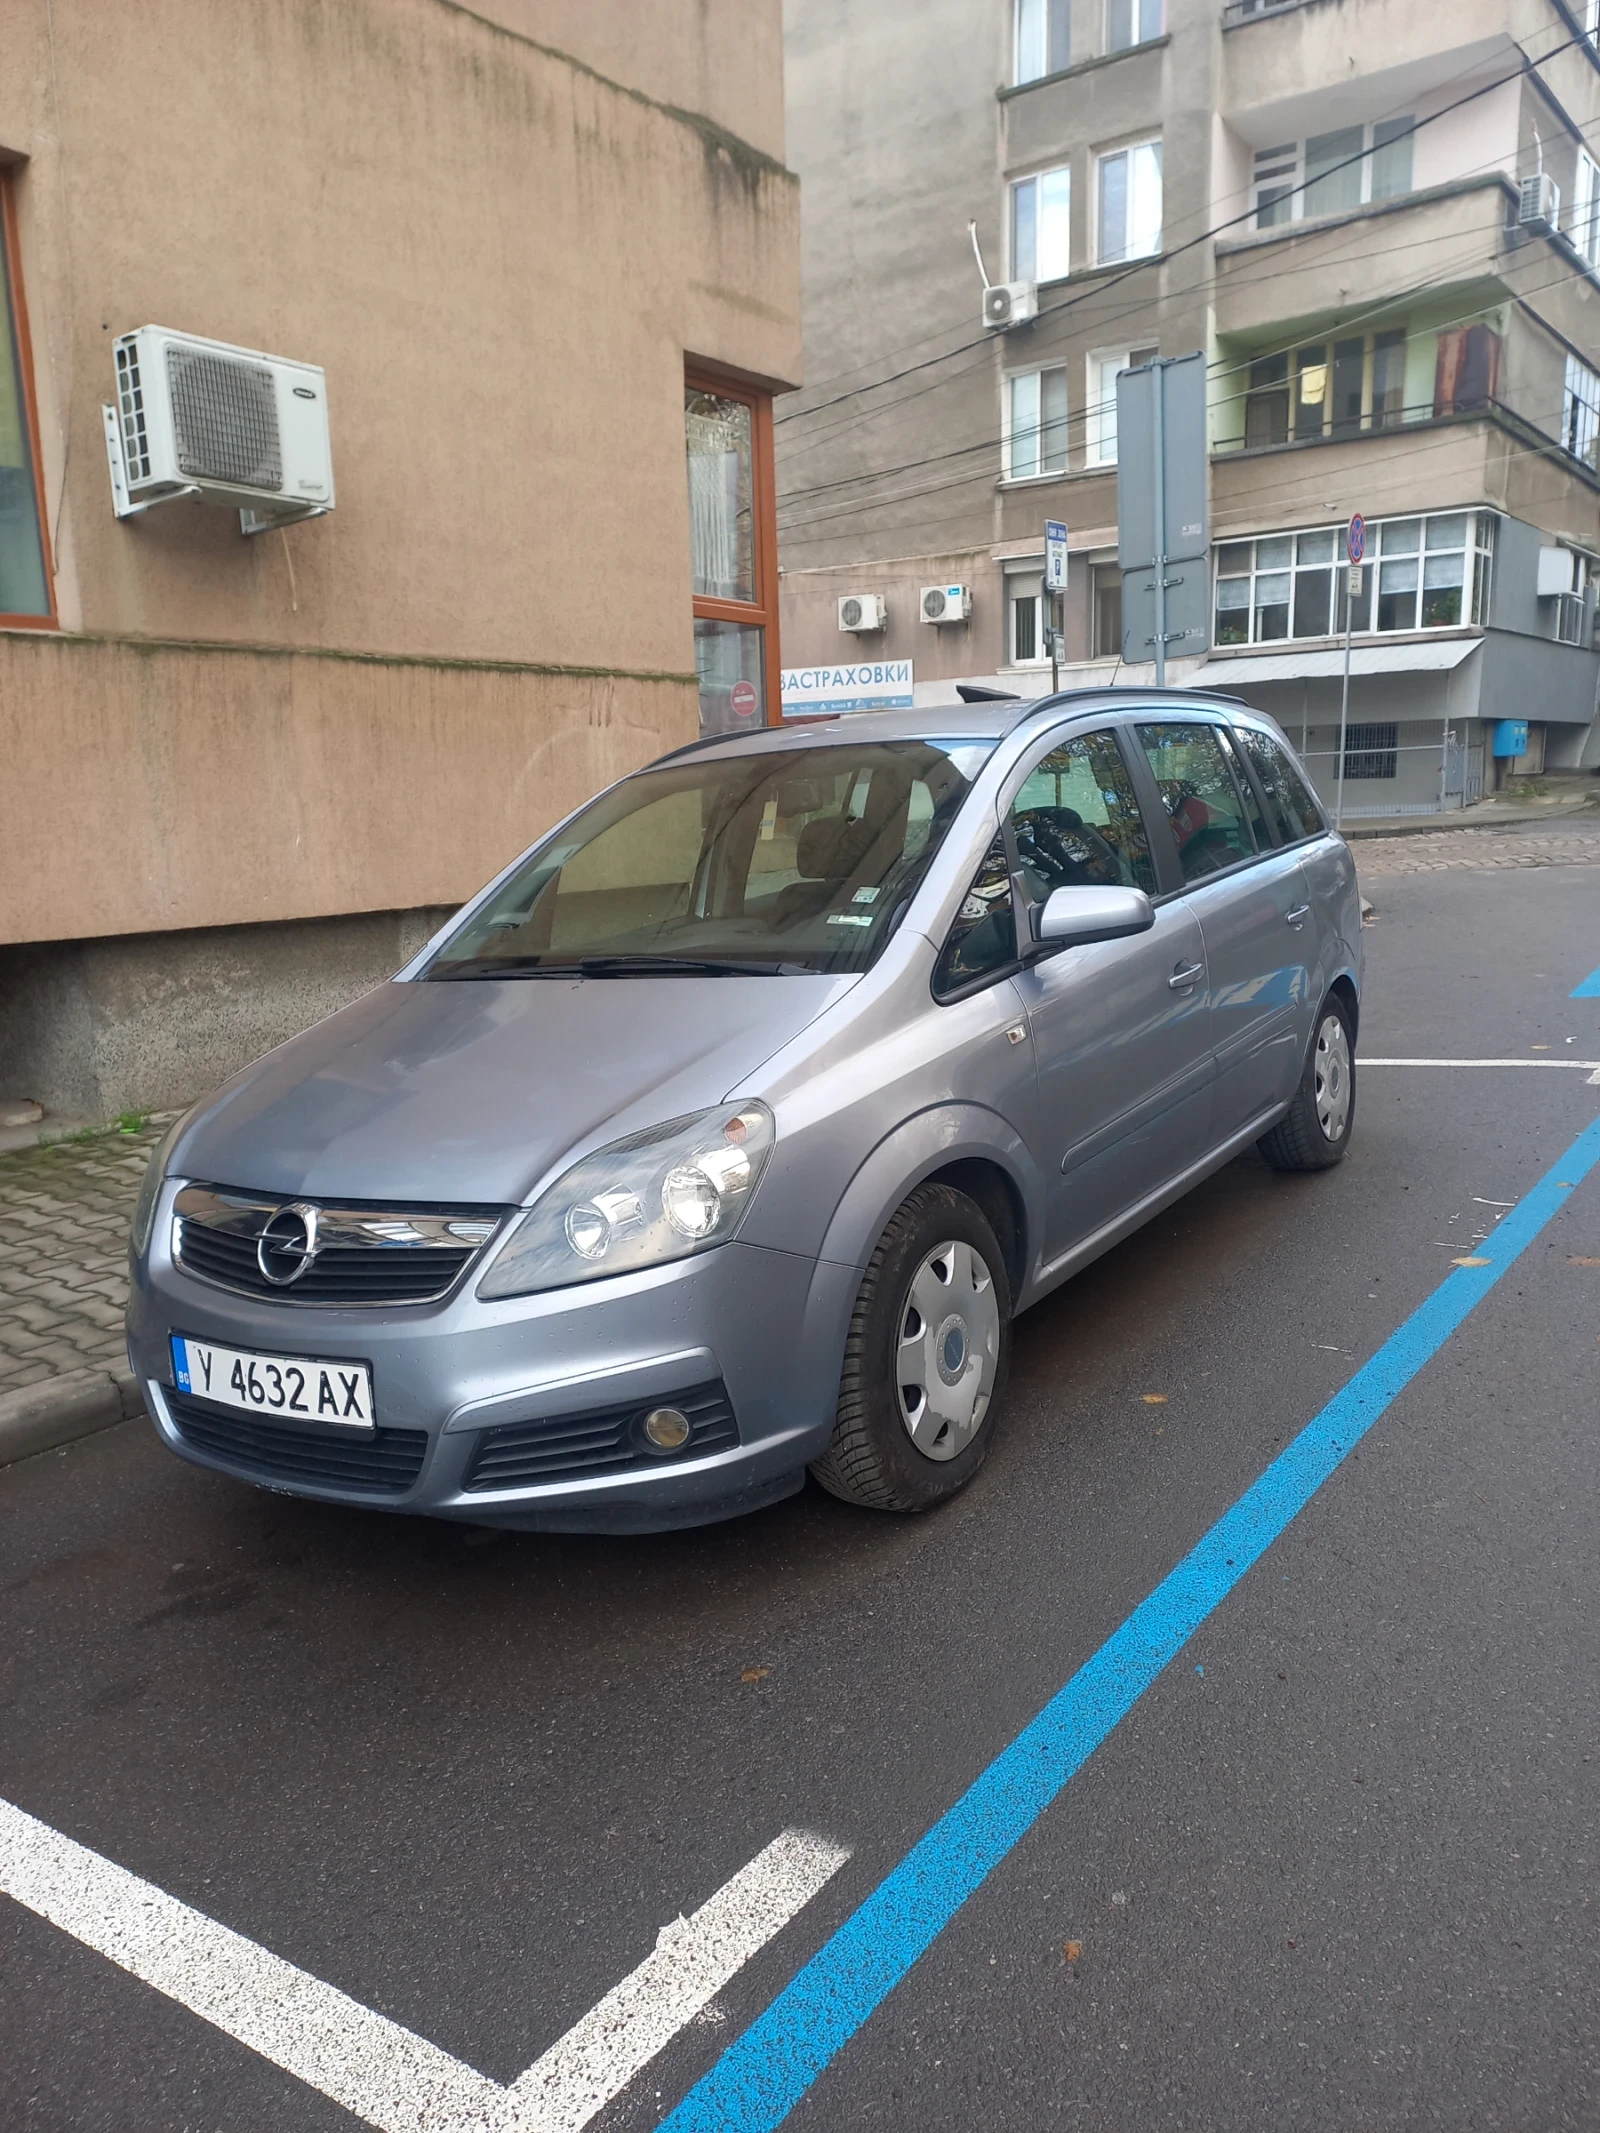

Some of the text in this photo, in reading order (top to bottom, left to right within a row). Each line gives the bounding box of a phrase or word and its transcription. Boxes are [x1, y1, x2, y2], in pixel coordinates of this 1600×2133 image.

[780, 664, 908, 691] ЗАСТРАХОВКИ
[178, 1371, 190, 1385] BG
[230, 1358, 309, 1412] 4632
